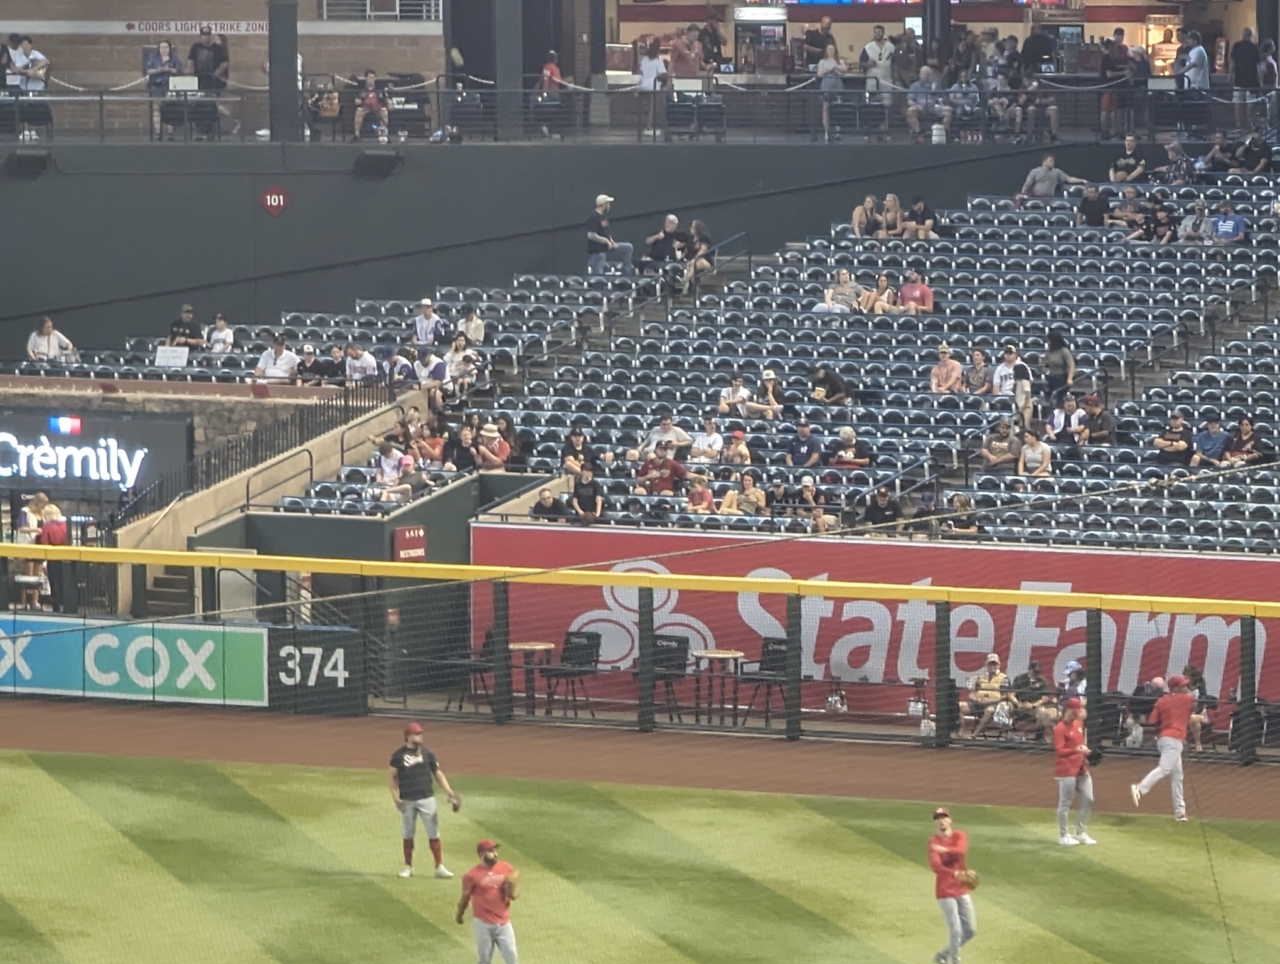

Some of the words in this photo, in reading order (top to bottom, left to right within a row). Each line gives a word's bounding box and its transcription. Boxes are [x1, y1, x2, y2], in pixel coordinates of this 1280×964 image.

[138, 22, 171, 32] COORS
[266, 194, 284, 206] 101
[737, 567, 997, 684] State
[1004, 581, 1267, 698] Farm
[85, 633, 216, 691] COX
[279, 645, 349, 687] 374
